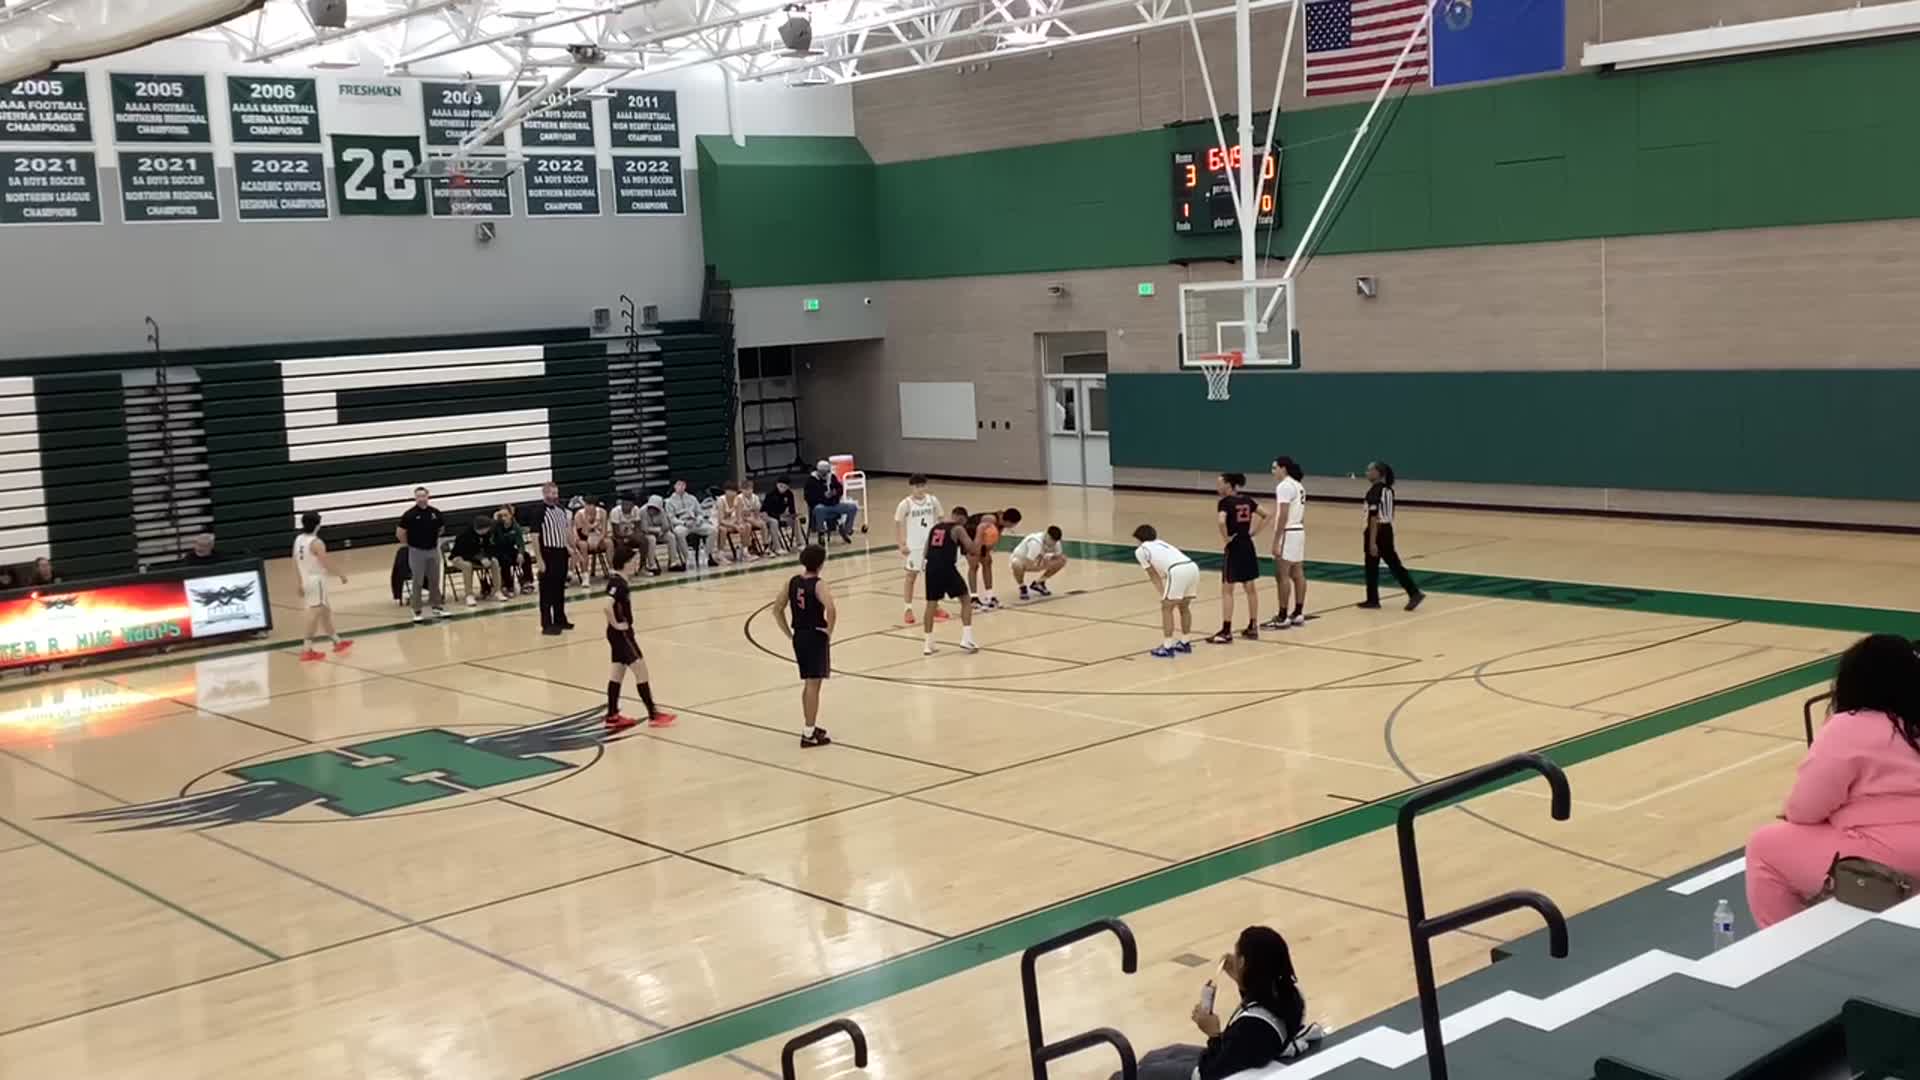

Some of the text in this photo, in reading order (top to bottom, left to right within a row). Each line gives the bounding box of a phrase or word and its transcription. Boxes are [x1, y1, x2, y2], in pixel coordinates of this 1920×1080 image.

[11, 81, 63, 95] 2005
[135, 82, 183, 97] 2005
[250, 83, 296, 99] 2006
[339, 84, 401, 97] FRESHMEN
[28, 101, 86, 111] FOOTBALL
[628, 95, 658, 108] 2011
[153, 103, 196, 113] FOOTBALL
[260, 104, 316, 114] BASKETBALL
[40, 112, 84, 122] LEAGUE
[274, 115, 309, 125] LEAGUE
[6, 123, 76, 133] CHAMPIONS
[137, 125, 190, 134] CHAMPIONS
[249, 126, 304, 136] CHAMPIONS
[14, 158, 77, 172] 2021
[138, 158, 197, 171] 2021
[251, 160, 309, 173] 2022
[537, 160, 584, 172] 2022
[625, 161, 670, 173] 2022
[170, 175, 205, 185] SOCCER
[342, 148, 416, 200] 28
[1186, 165, 1196, 187] 3
[50, 176, 86, 187] SOCCER
[241, 180, 283, 192] ACADEMIC
[56, 192, 91, 202] LEAGUE
[1262, 195, 1272, 212] 0
[23, 207, 77, 217] CHAMPIONS
[146, 206, 198, 215] CHAMPIONS
[1184, 203, 1189, 217] 1
